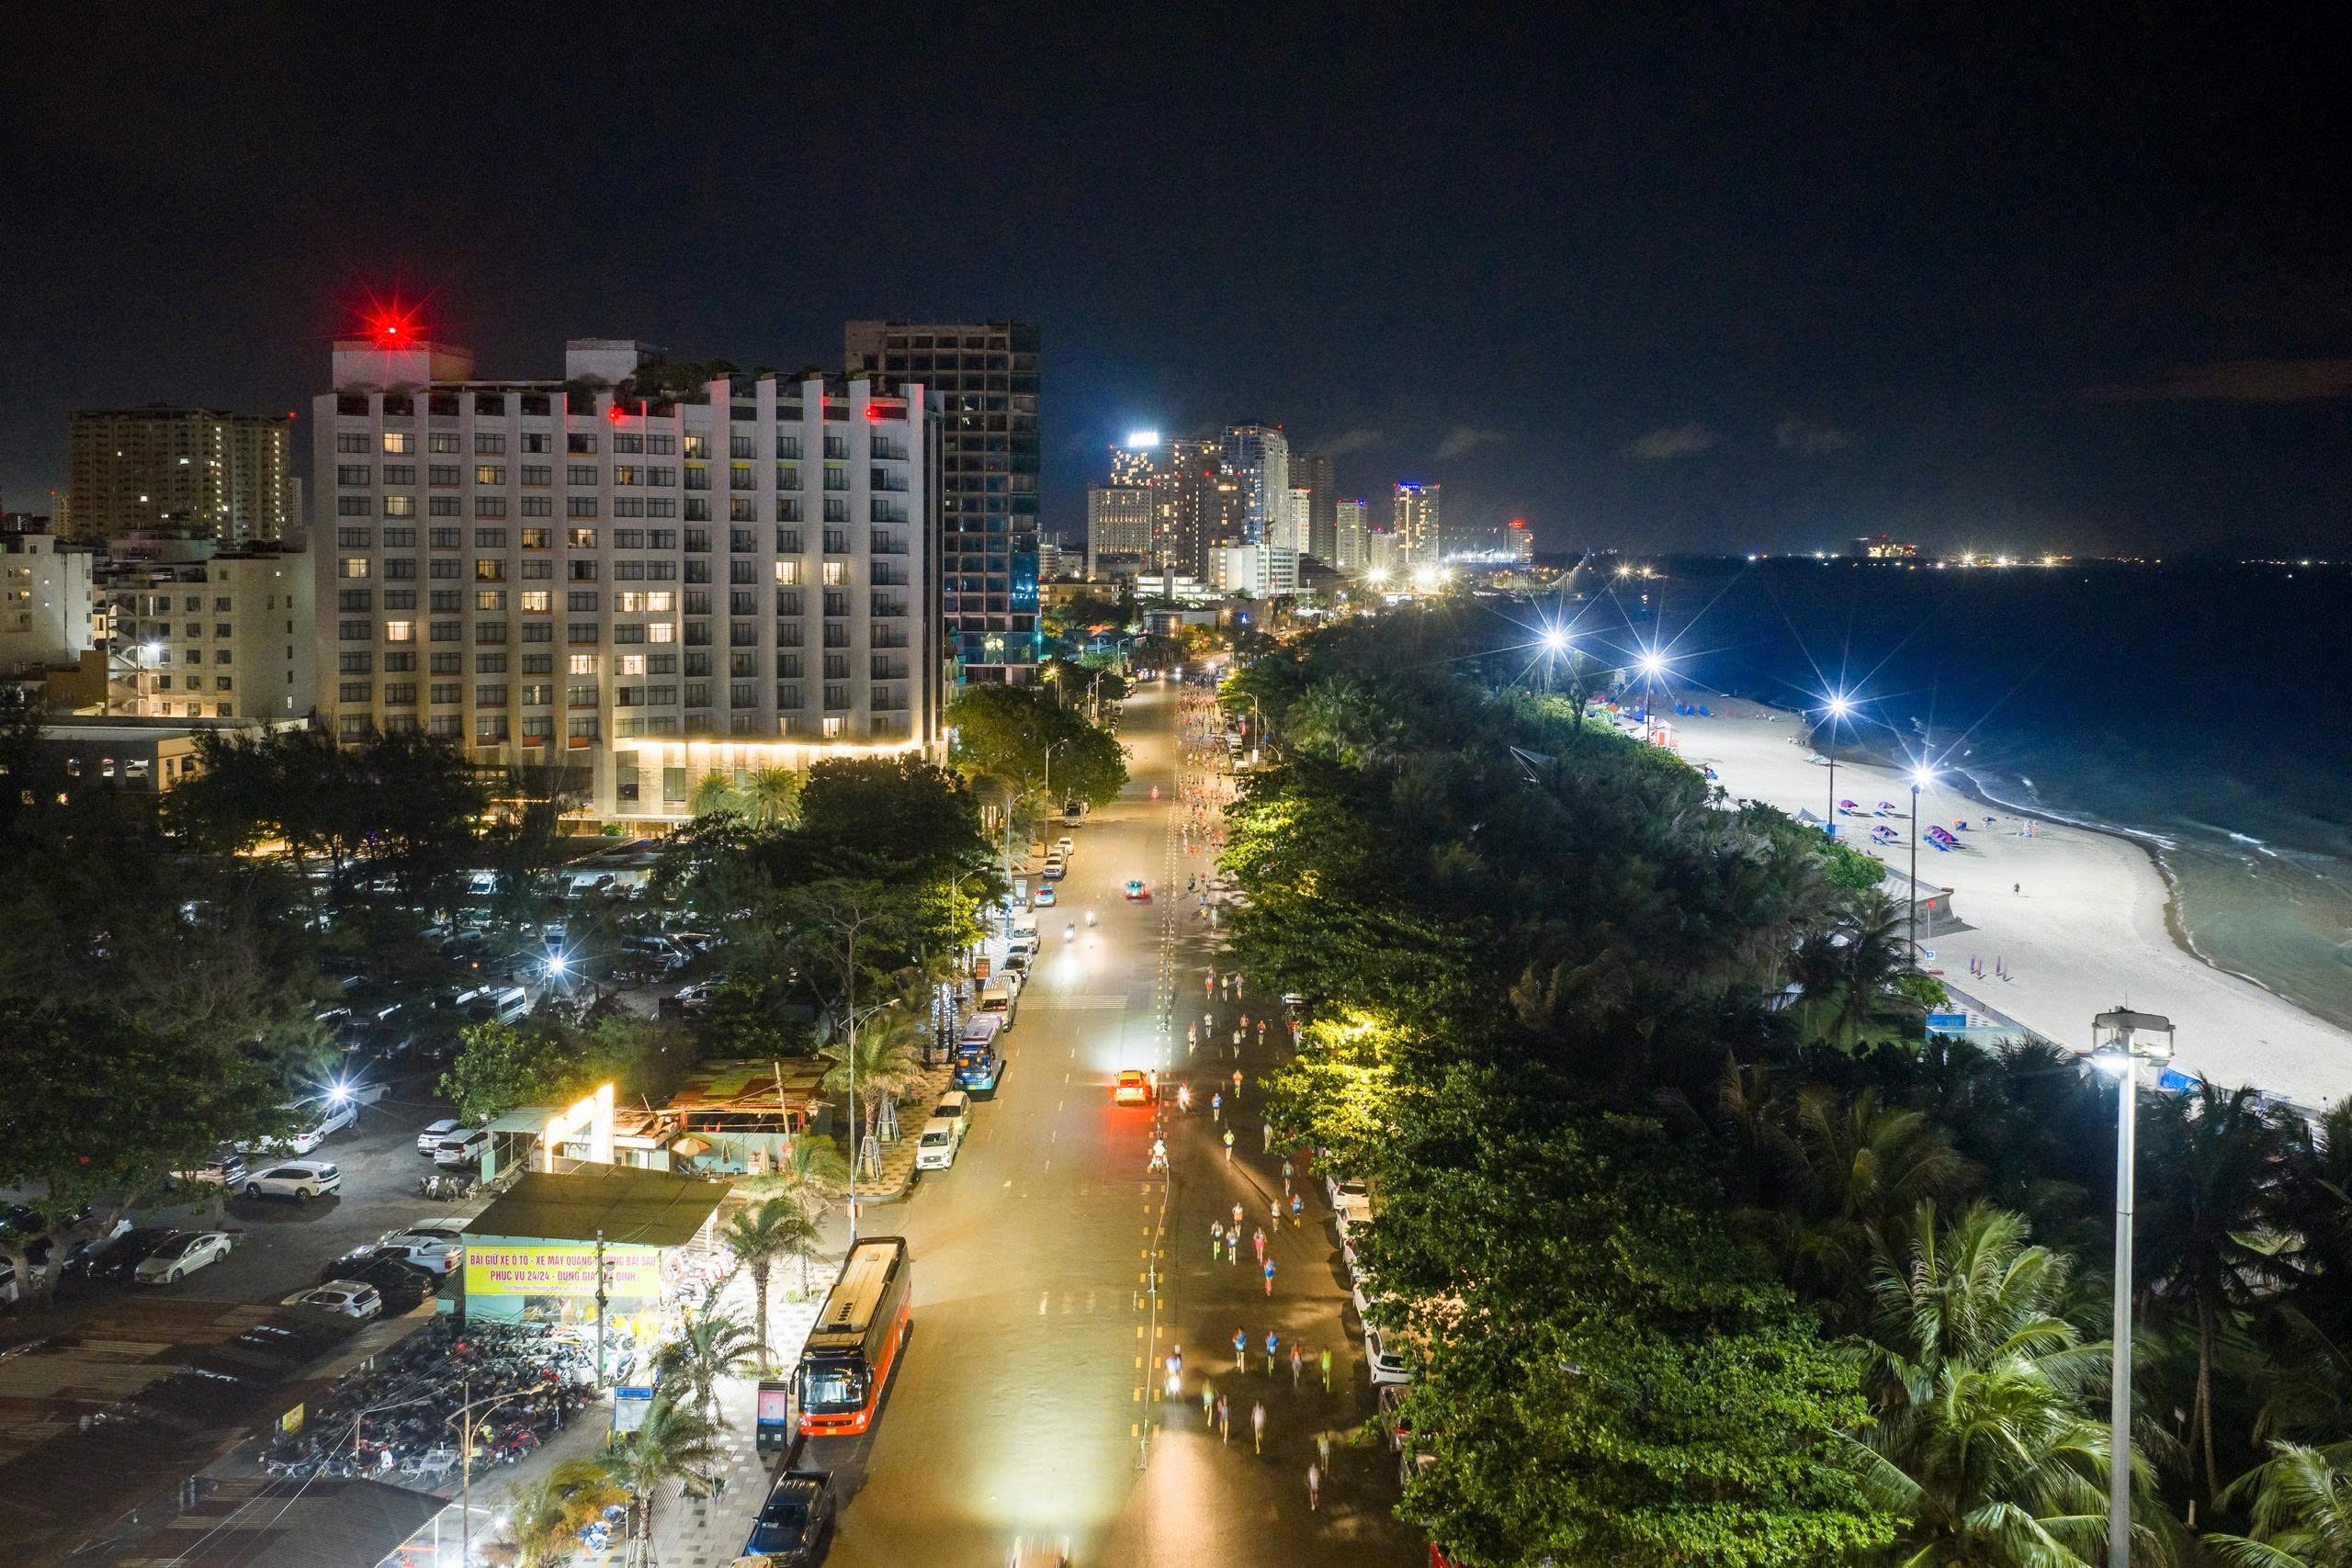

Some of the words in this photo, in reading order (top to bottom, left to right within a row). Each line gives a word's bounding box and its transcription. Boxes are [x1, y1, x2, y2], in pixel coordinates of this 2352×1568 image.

[500, 1255, 510, 1265] XE
[536, 1256, 545, 1265] XE
[641, 1256, 656, 1266] SAU
[527, 1270, 549, 1280] 24/24
